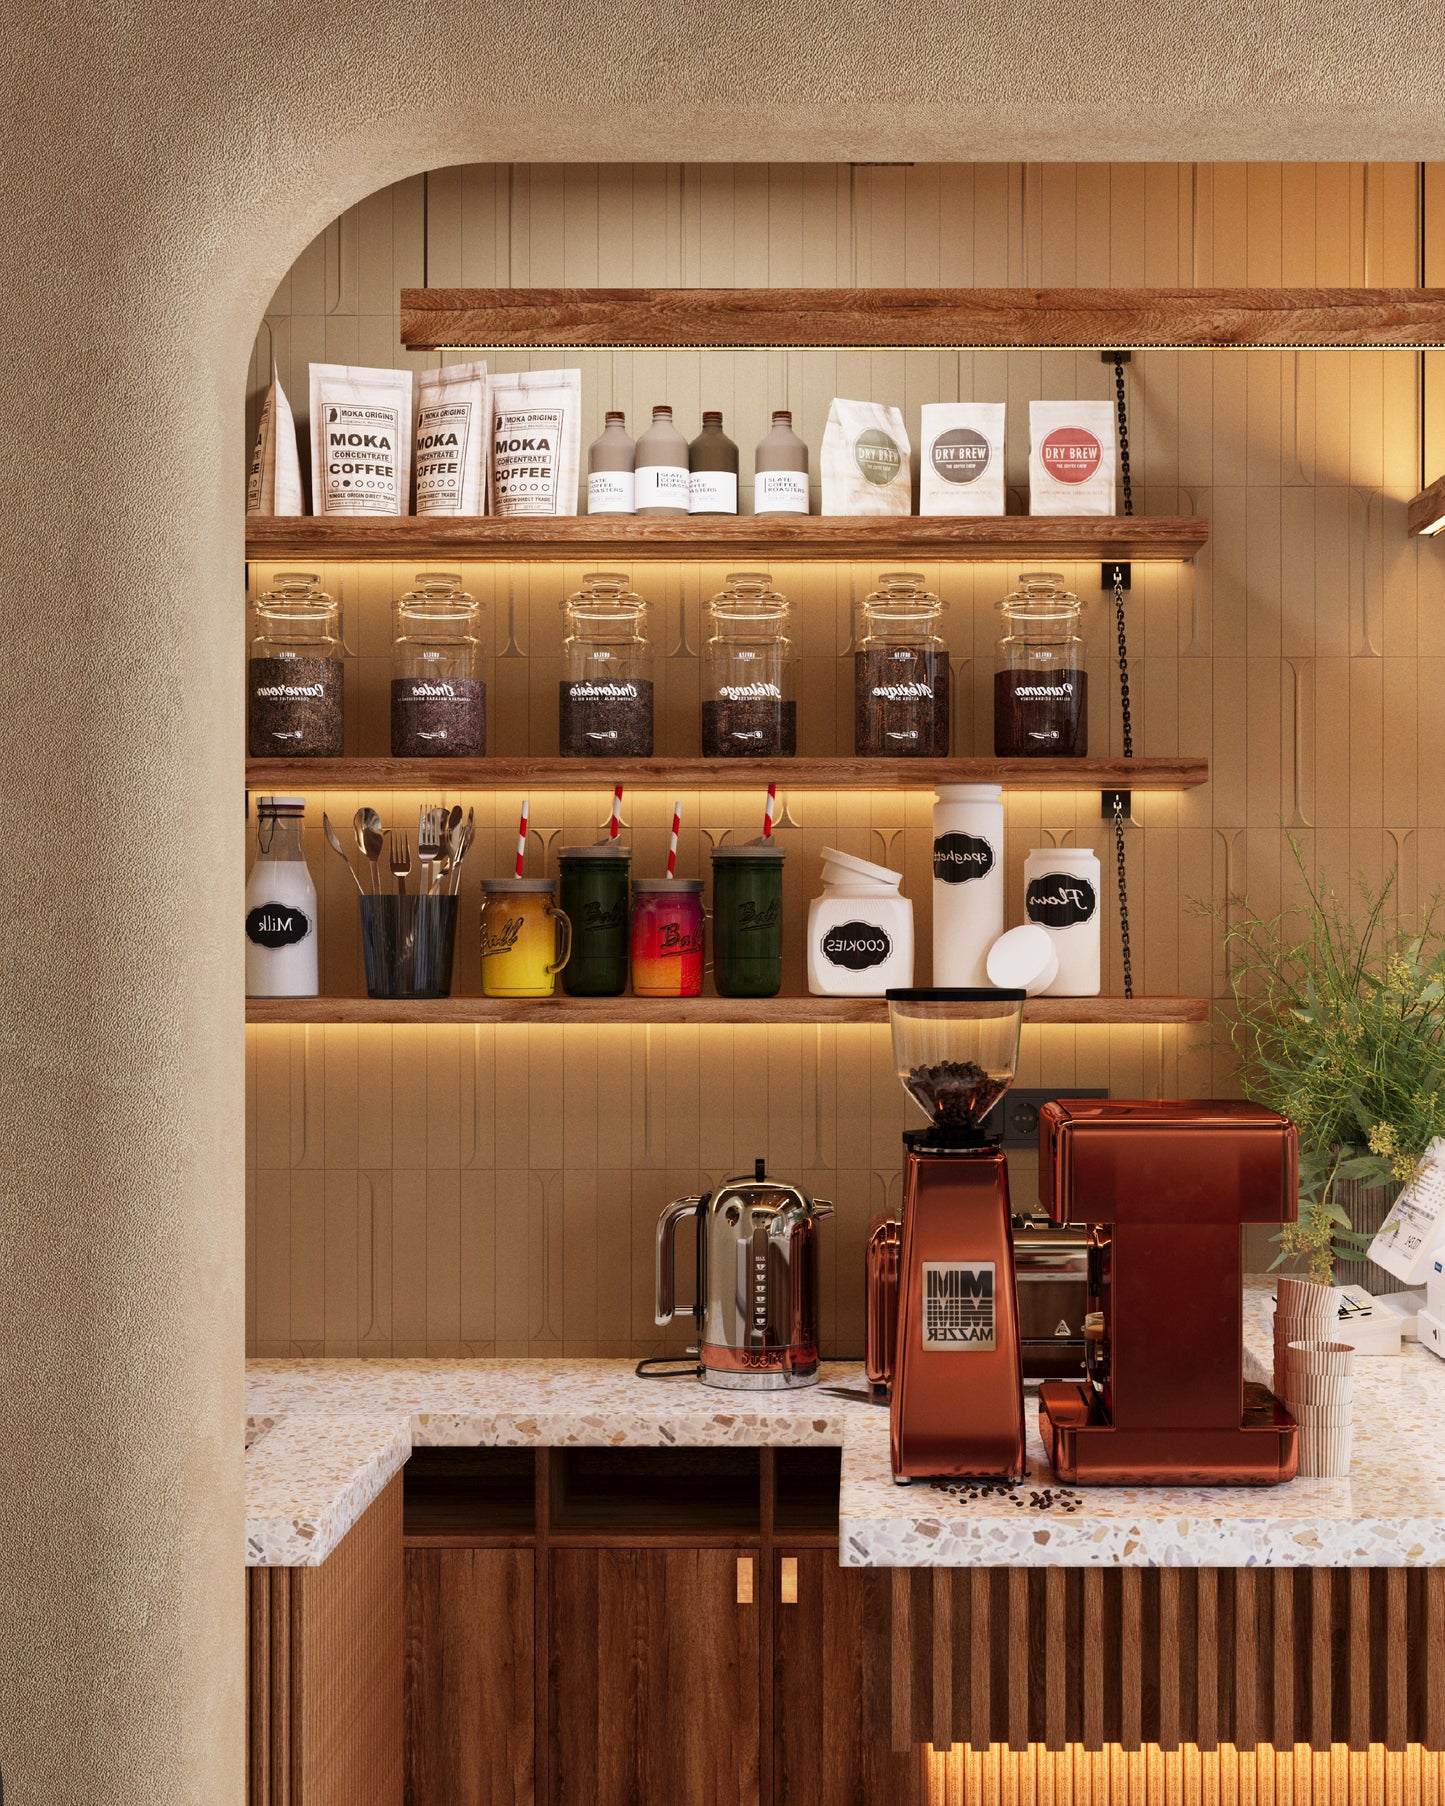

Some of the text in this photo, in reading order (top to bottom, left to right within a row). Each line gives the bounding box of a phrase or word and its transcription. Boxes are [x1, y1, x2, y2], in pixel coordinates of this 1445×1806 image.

[342, 410, 394, 421] MOKA ORIGINS
[425, 408, 466, 420] MOKA ORIGINS
[330, 433, 391, 450] MOKA
[417, 433, 458, 451] MOKA
[496, 438, 550, 454] MOKA
[334, 451, 390, 461] CONCENTRATE
[858, 448, 899, 463] DRY BREW
[936, 448, 986, 460] DRY BREW
[1046, 448, 1097, 459] DRY BREW
[329, 464, 394, 478] COFFEE
[417, 463, 458, 478] OFFEE
[496, 468, 552, 482] COFFEE
